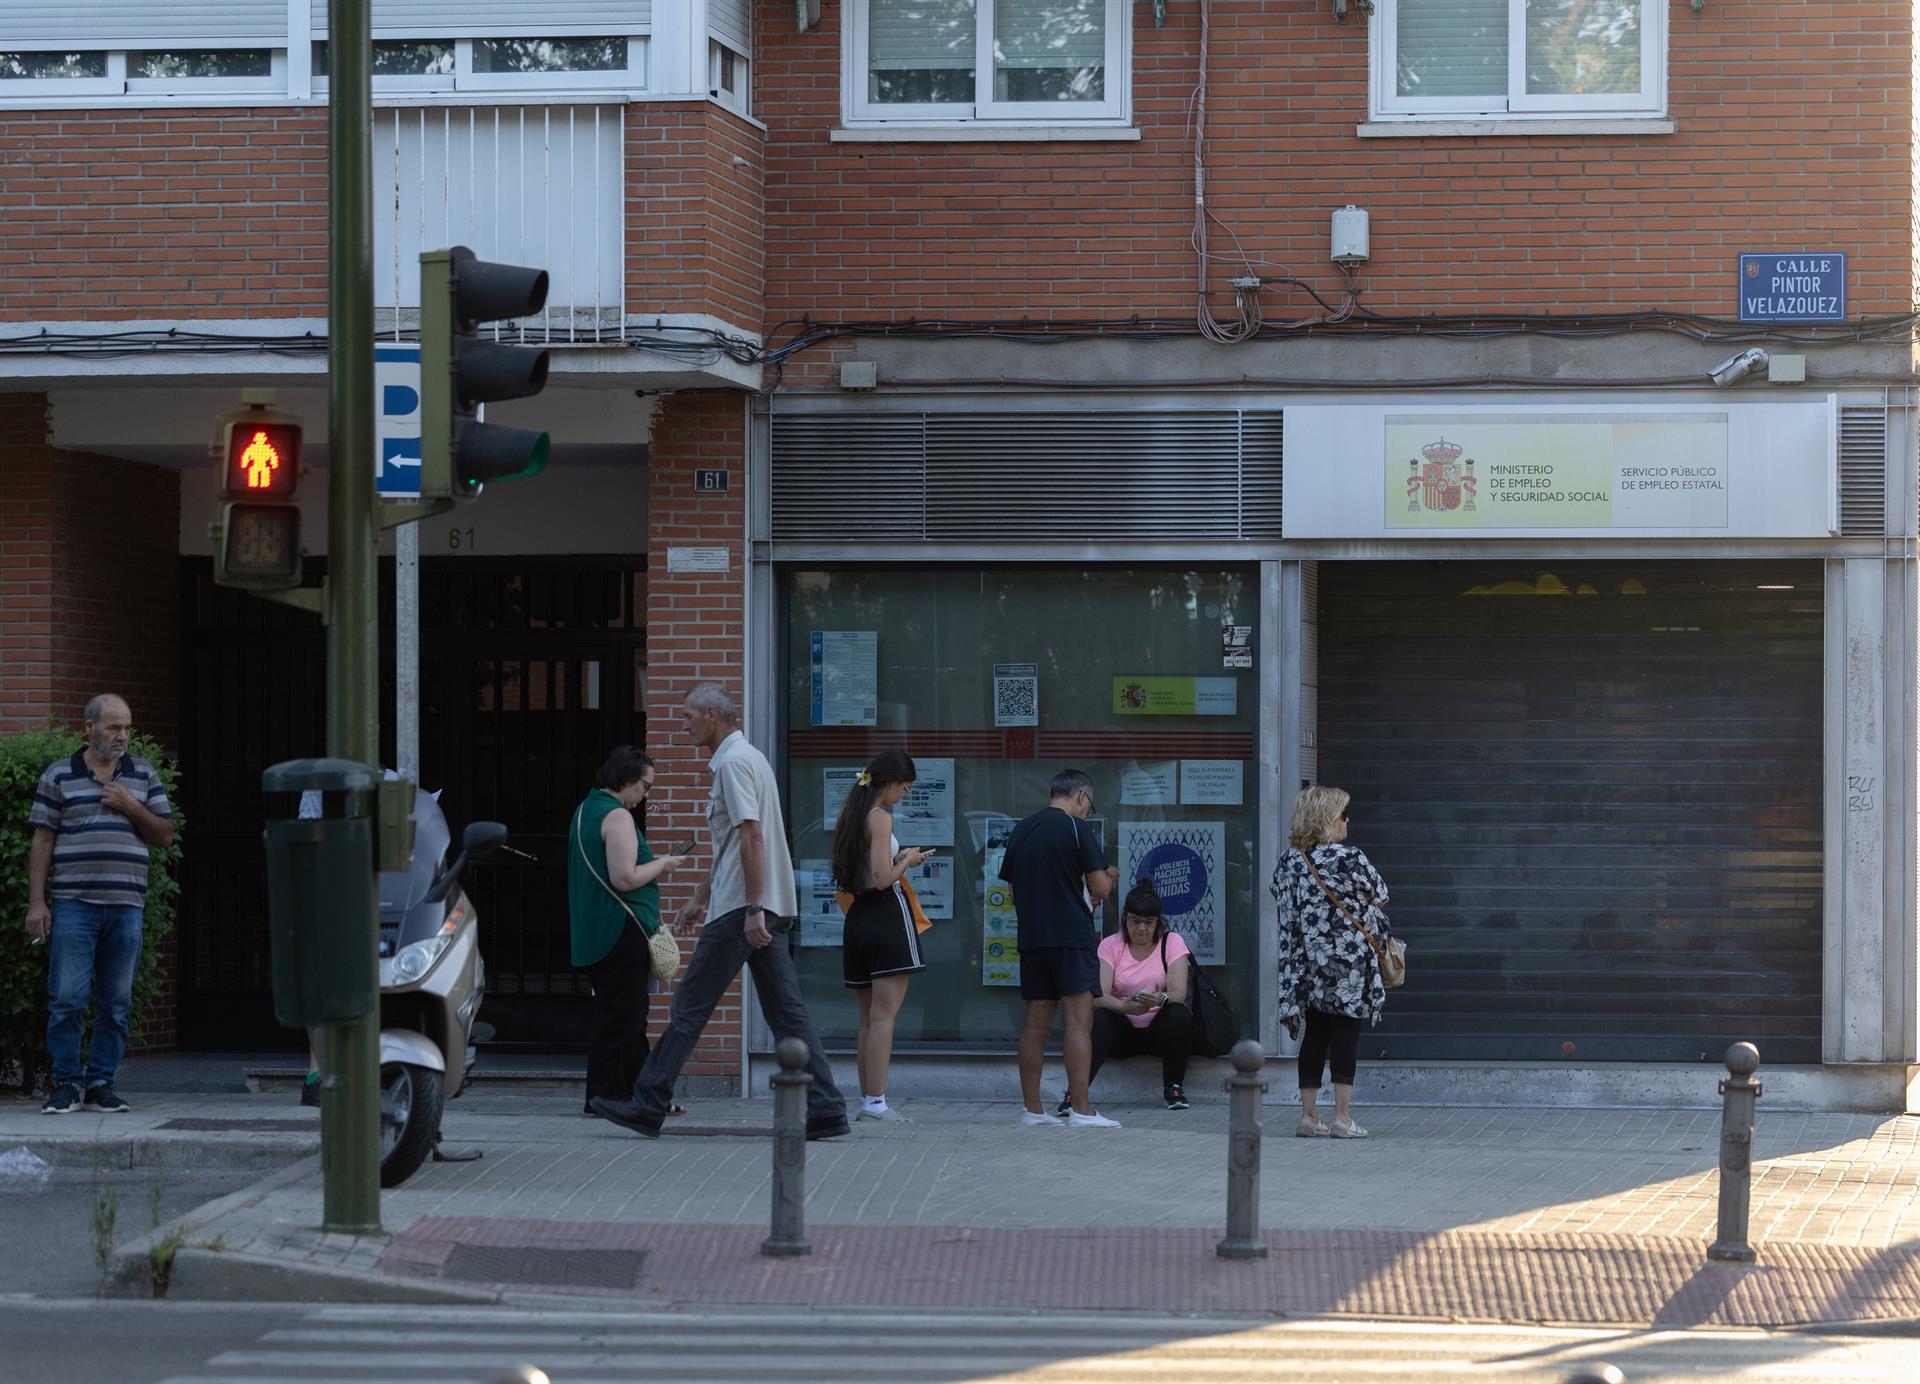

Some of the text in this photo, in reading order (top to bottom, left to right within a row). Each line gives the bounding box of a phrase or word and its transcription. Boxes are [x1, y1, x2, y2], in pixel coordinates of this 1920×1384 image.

[1776, 260, 1831, 273] CALLE
[1771, 276, 1821, 293] PINTOR
[1747, 297, 1838, 314] VELAZQUEZ
[374, 361, 422, 478] P
[1490, 465, 1553, 475] MINISTERIO
[1621, 465, 1717, 477] SERVICIO PÚBLICO
[704, 472, 720, 489] 61
[1490, 479, 1551, 488] DE EMPLEO
[1621, 480, 1724, 490] DE EMPLEO ESTATAL
[1490, 492, 1609, 502] Y SEGURIDAD SOCIAL
[449, 527, 475, 550] 61
[1159, 858, 1190, 871] VIOLENCIA
[1154, 865, 1191, 880] MACHISTA
[1161, 875, 1189, 886] PARAMOS
